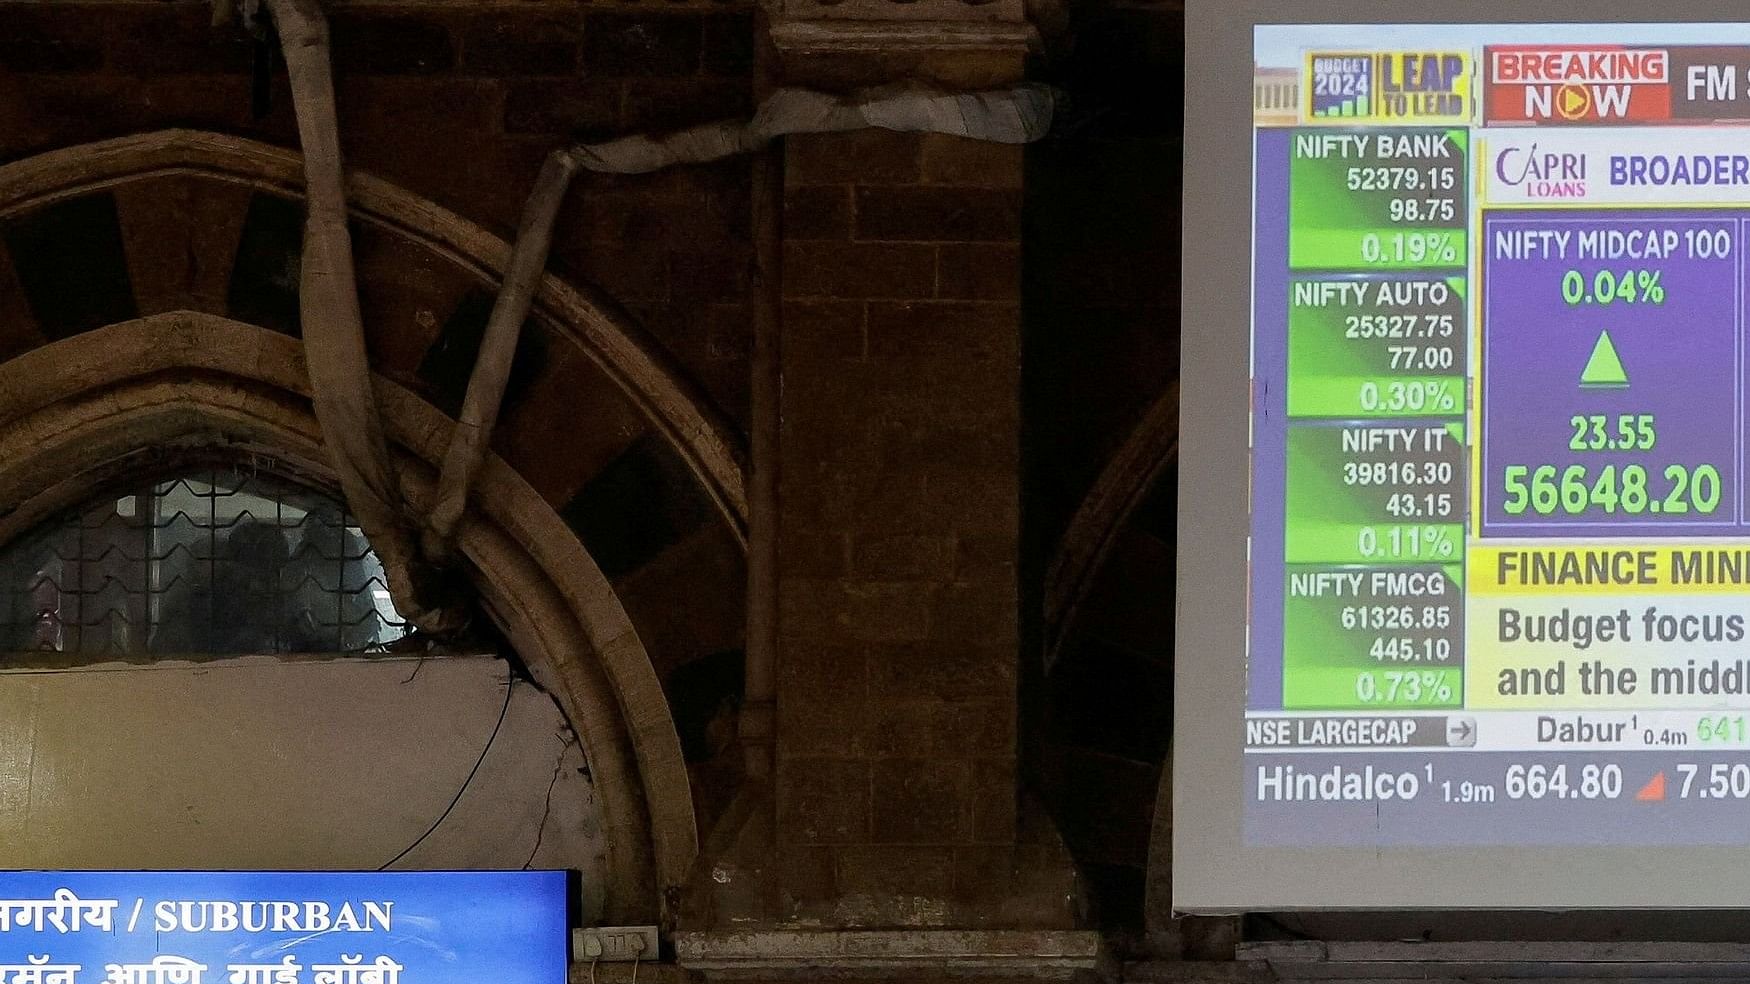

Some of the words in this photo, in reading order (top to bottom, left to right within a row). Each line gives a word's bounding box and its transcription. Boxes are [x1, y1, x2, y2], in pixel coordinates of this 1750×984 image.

[1314, 58, 1368, 73] BUDGET
[1383, 55, 1463, 92] LEAP
[1493, 53, 1664, 81] BREAKING
[1315, 74, 1368, 96] 2024
[1687, 65, 1737, 100] FM
[1383, 95, 1407, 116] TO
[1413, 95, 1463, 116] LEAD
[1295, 134, 1369, 157] NIFTY
[1377, 134, 1449, 157] BANK
[1495, 142, 1586, 183] CAPRI
[1609, 156, 1750, 186] BROADER
[1347, 167, 1454, 191] 52379.15
[1527, 182, 1586, 197] LOANS
[1389, 199, 1454, 221] 98.75
[1361, 234, 1456, 263] 0.19%
[1496, 231, 1570, 260] NIFTY
[1579, 230, 1679, 259] MIDCAP
[1685, 229, 1731, 258] 100
[1294, 282, 1366, 306] NIFTY
[1374, 281, 1448, 305] AUTO
[1562, 271, 1664, 305] 0.04%
[1345, 314, 1453, 338] 25327.75
[1387, 347, 1453, 369] 77.00
[1360, 382, 1455, 411] 0.30%
[1342, 430, 1416, 452] NIFTY
[1423, 429, 1447, 452] IT
[1569, 414, 1656, 450] 23.55
[1343, 462, 1452, 486] 39816.30
[1503, 464, 1721, 515] 56648.20
[1386, 495, 1452, 517] 43.15
[1357, 528, 1453, 557] 0.11%
[1497, 553, 1656, 586] FINANCE
[1290, 574, 1364, 597] NIFTY
[1371, 573, 1445, 597] FMCG
[1341, 606, 1450, 630] 61326.85
[1498, 608, 1631, 646] Budget
[1644, 606, 1744, 643] focus
[1370, 638, 1450, 661] 445.10
[1355, 673, 1452, 702] 0.73%
[1498, 662, 1563, 697] and
[1579, 662, 1637, 696] the
[1246, 719, 1291, 745] NSE
[1297, 718, 1417, 745] LARGECAP
[1537, 717, 1626, 745] Dabur
[1644, 729, 1688, 746] 0.4m
[1257, 765, 1419, 801] Hindalco
[1442, 780, 1495, 803] 1.9m
[1506, 763, 1623, 800] 664.80
[1677, 763, 1750, 799] 7.50
[154, 899, 394, 932] SUBURBAN
